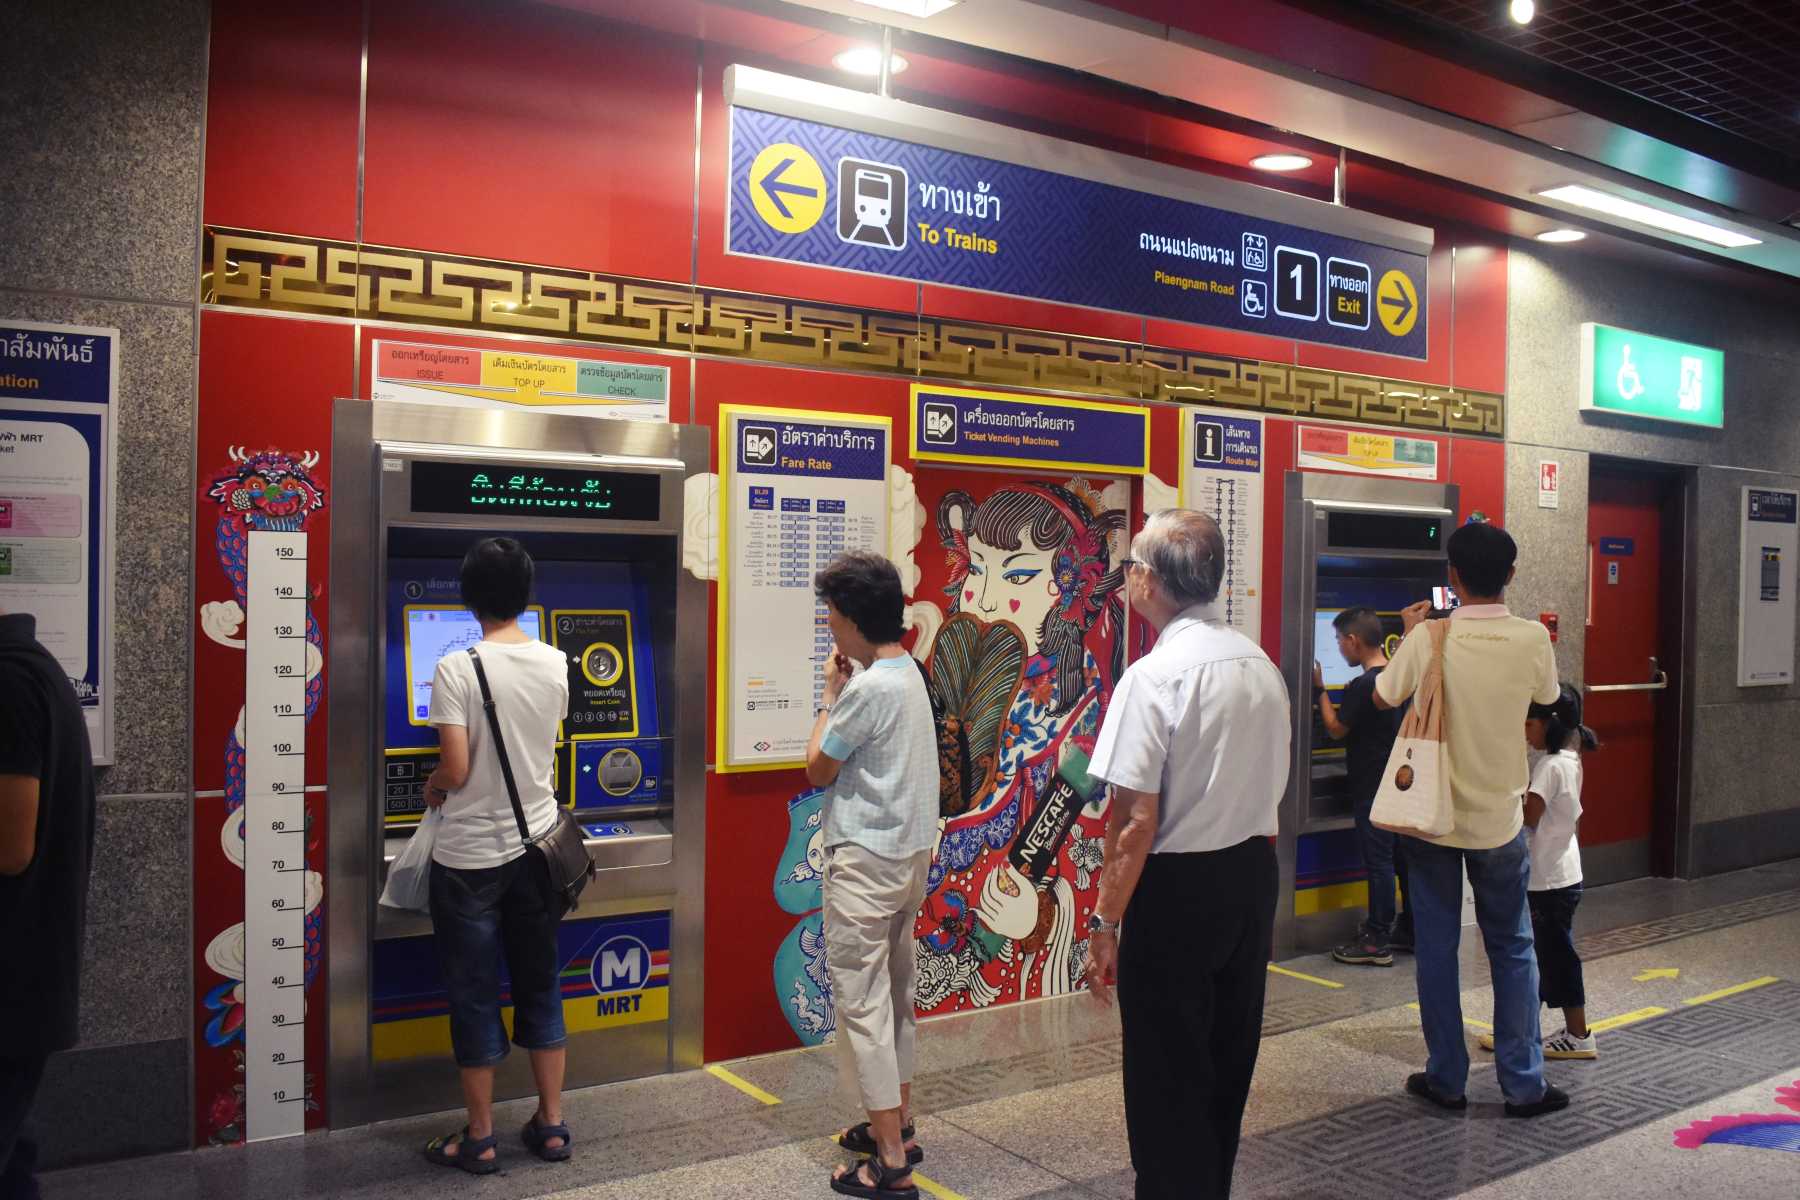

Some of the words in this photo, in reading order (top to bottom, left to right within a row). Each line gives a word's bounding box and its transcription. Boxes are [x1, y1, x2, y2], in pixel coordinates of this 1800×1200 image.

[919, 181, 1001, 222] ทางเข้า
[918, 223, 939, 245] To
[944, 227, 998, 254] Trains
[1139, 232, 1235, 266] ถนนแปลงนาม
[1154, 271, 1208, 293] Plaengnam
[1210, 281, 1235, 296] Road
[1289, 264, 1303, 301] 1
[1329, 272, 1368, 294] ทางออก
[1337, 296, 1361, 315] Exit
[416, 369, 444, 380] ISSUE
[513, 377, 531, 388] TOP
[533, 378, 545, 389] UP
[607, 385, 637, 397] CHECK
[963, 403, 1075, 432] เครื่องออกบัตรโดยสาร
[20, 433, 44, 443] MRT
[782, 425, 876, 450] อัตราค่าบริการ
[964, 431, 987, 442] Ticket
[988, 433, 1020, 446] Vending
[1022, 435, 1060, 447] Machines
[781, 456, 804, 469] Fare
[808, 458, 832, 470] Rate
[1225, 455, 1244, 465] Route
[1245, 458, 1258, 468] Map
[275, 548, 294, 557] 150
[274, 587, 293, 596] 140
[274, 626, 292, 635] 130
[273, 665, 292, 674] 120
[273, 704, 292, 713] 110
[273, 744, 291, 752] 100
[272, 783, 285, 792] 90
[272, 821, 285, 831] 80
[272, 860, 285, 870] 70
[272, 899, 285, 908] 60
[272, 938, 285, 947] 50
[601, 947, 641, 987] M
[272, 976, 285, 985] 40
[597, 994, 643, 1017] MRT
[272, 1015, 285, 1024] 30
[272, 1053, 285, 1062] 20
[272, 1091, 285, 1100] 10
